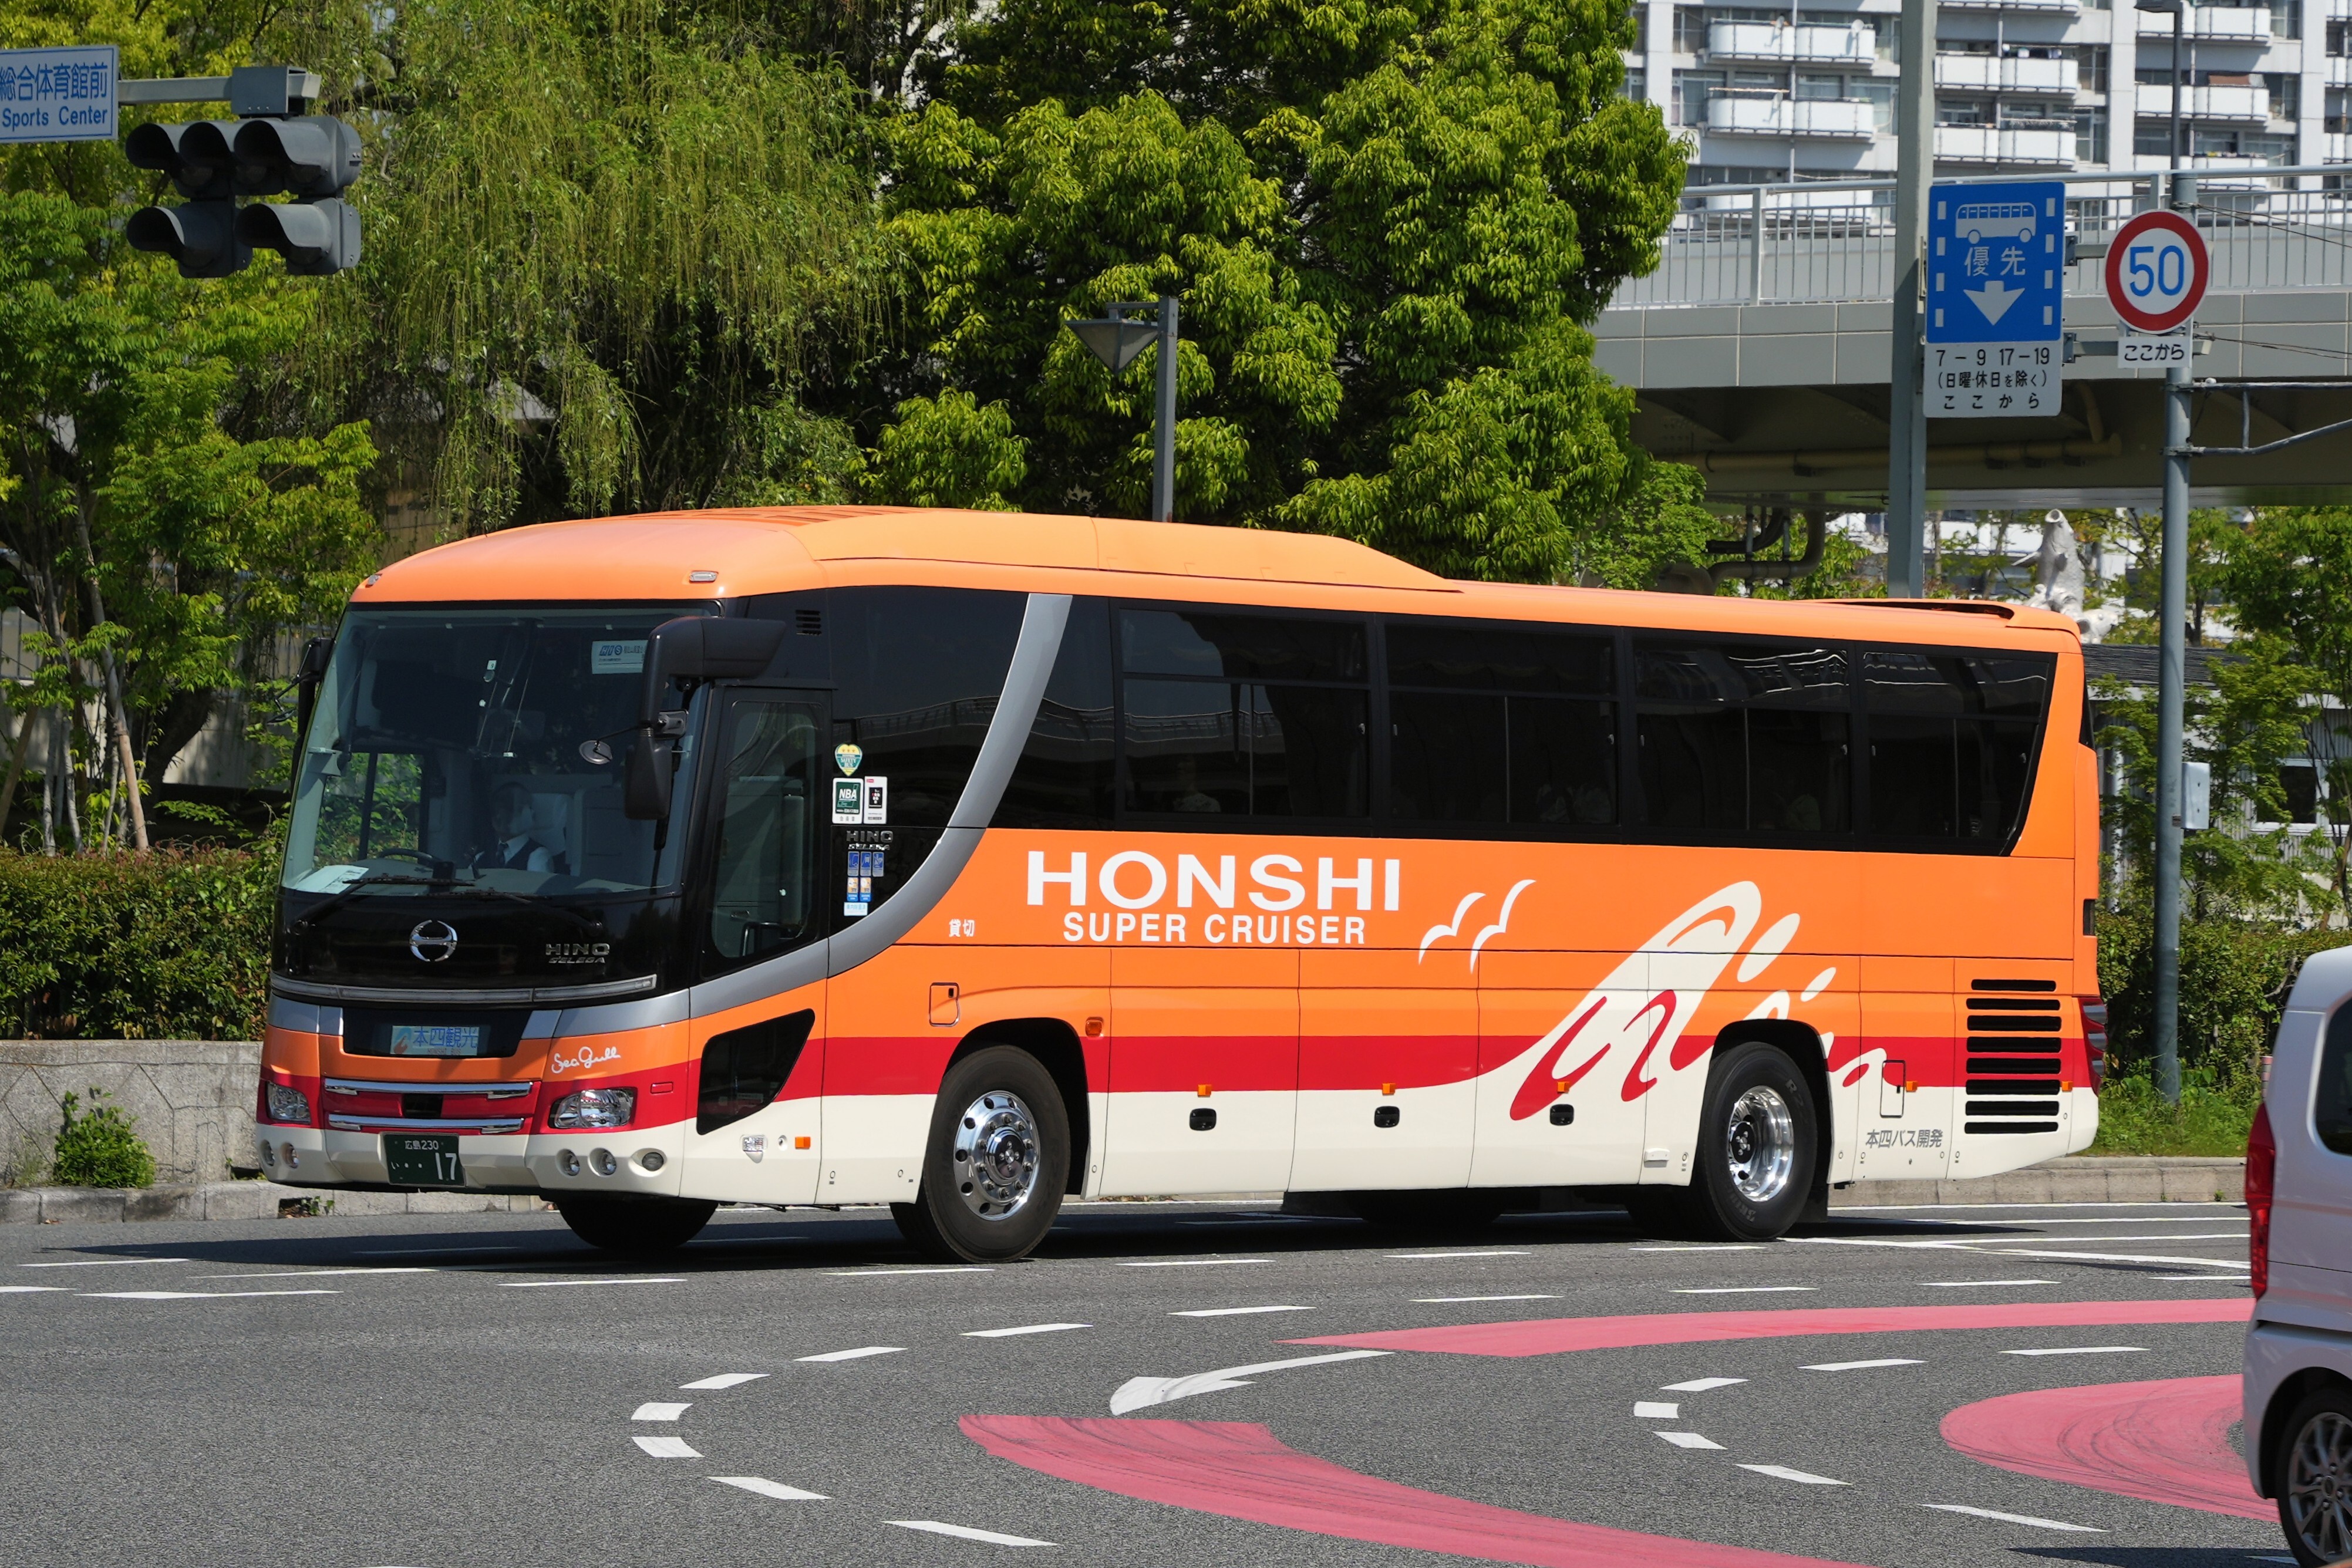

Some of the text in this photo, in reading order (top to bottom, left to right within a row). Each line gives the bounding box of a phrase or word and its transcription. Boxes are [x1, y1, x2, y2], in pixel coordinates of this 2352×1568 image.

[0, 62, 107, 102] 総合体育館前
[2, 106, 107, 131] Sports Center
[1963, 245, 2026, 277] 優先
[2129, 245, 2185, 297] 50
[2124, 343, 2185, 362] ここから
[1943, 392, 2040, 410] ここから
[838, 788, 857, 800] NBA
[846, 830, 894, 843] HINO
[1026, 850, 1400, 912] HONSHI
[949, 919, 975, 938] 貸切
[1063, 911, 1366, 945] SUPER CRUISER
[545, 943, 610, 956] HINO
[413, 1026, 479, 1048] 本四観光
[1865, 1129, 1943, 1149] 本四バス開発
